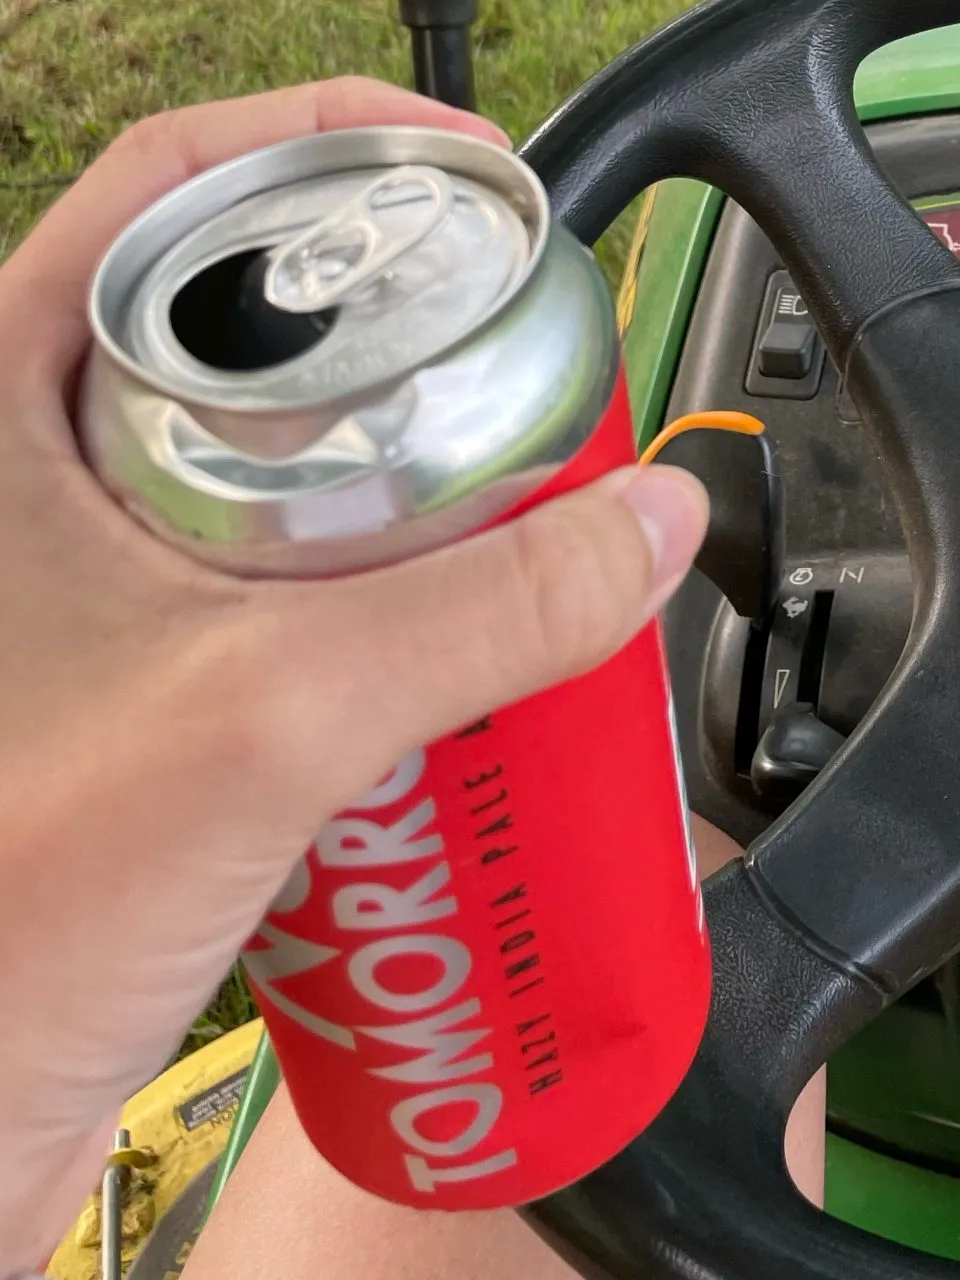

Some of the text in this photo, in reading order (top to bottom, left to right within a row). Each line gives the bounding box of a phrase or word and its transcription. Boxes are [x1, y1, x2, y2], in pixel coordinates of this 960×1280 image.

[463, 762, 520, 866] PALE
[490, 882, 546, 998] INDIA
[516, 1012, 563, 1097] HAZY
